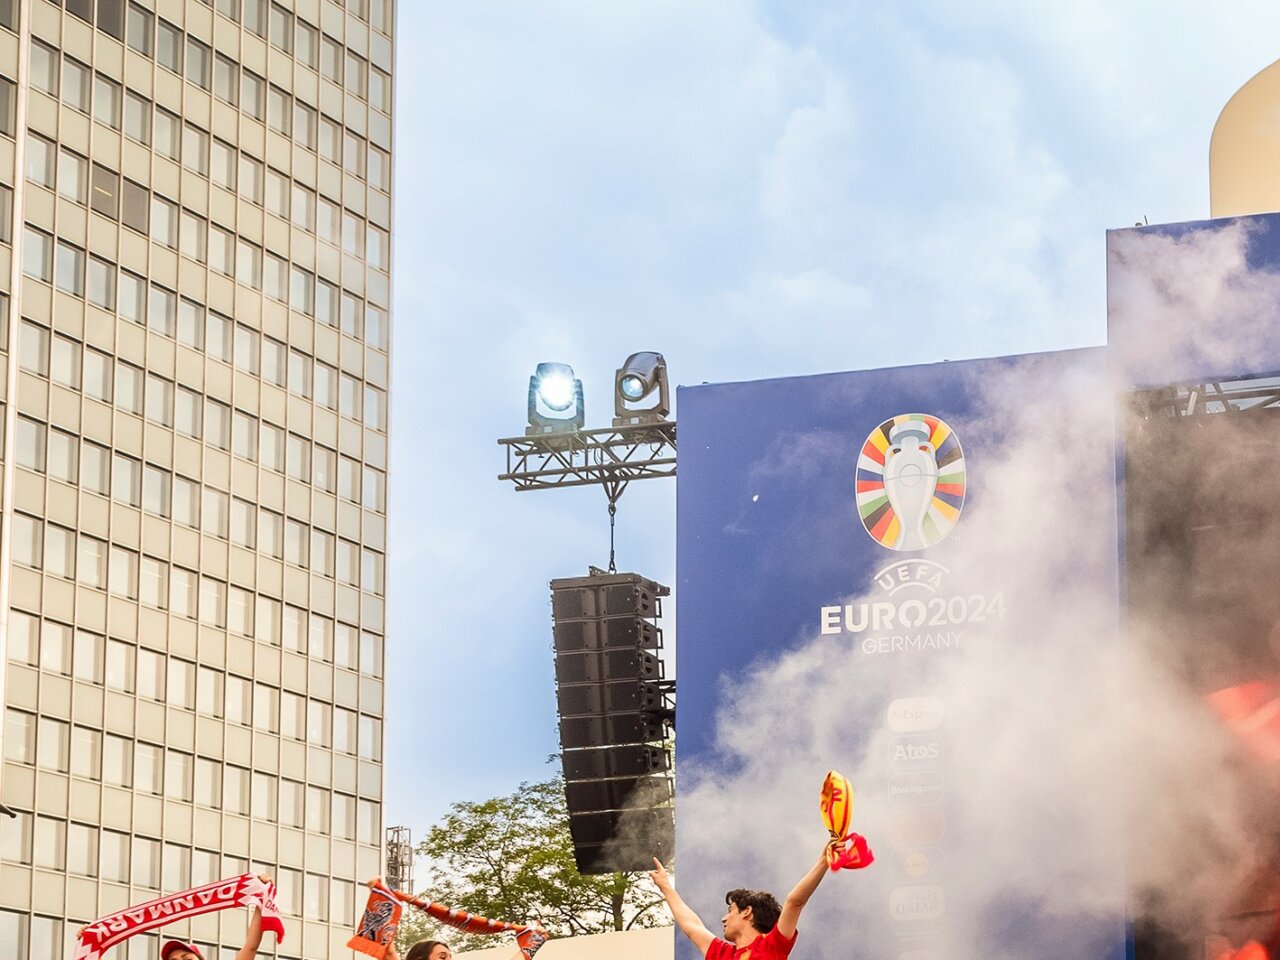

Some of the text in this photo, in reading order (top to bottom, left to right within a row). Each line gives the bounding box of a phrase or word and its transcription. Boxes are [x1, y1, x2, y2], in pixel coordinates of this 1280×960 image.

[878, 566, 943, 592] UEFA
[820, 592, 1008, 635] EURO2024
[862, 631, 965, 655] GERMANY
[85, 882, 238, 943] DANMARK
